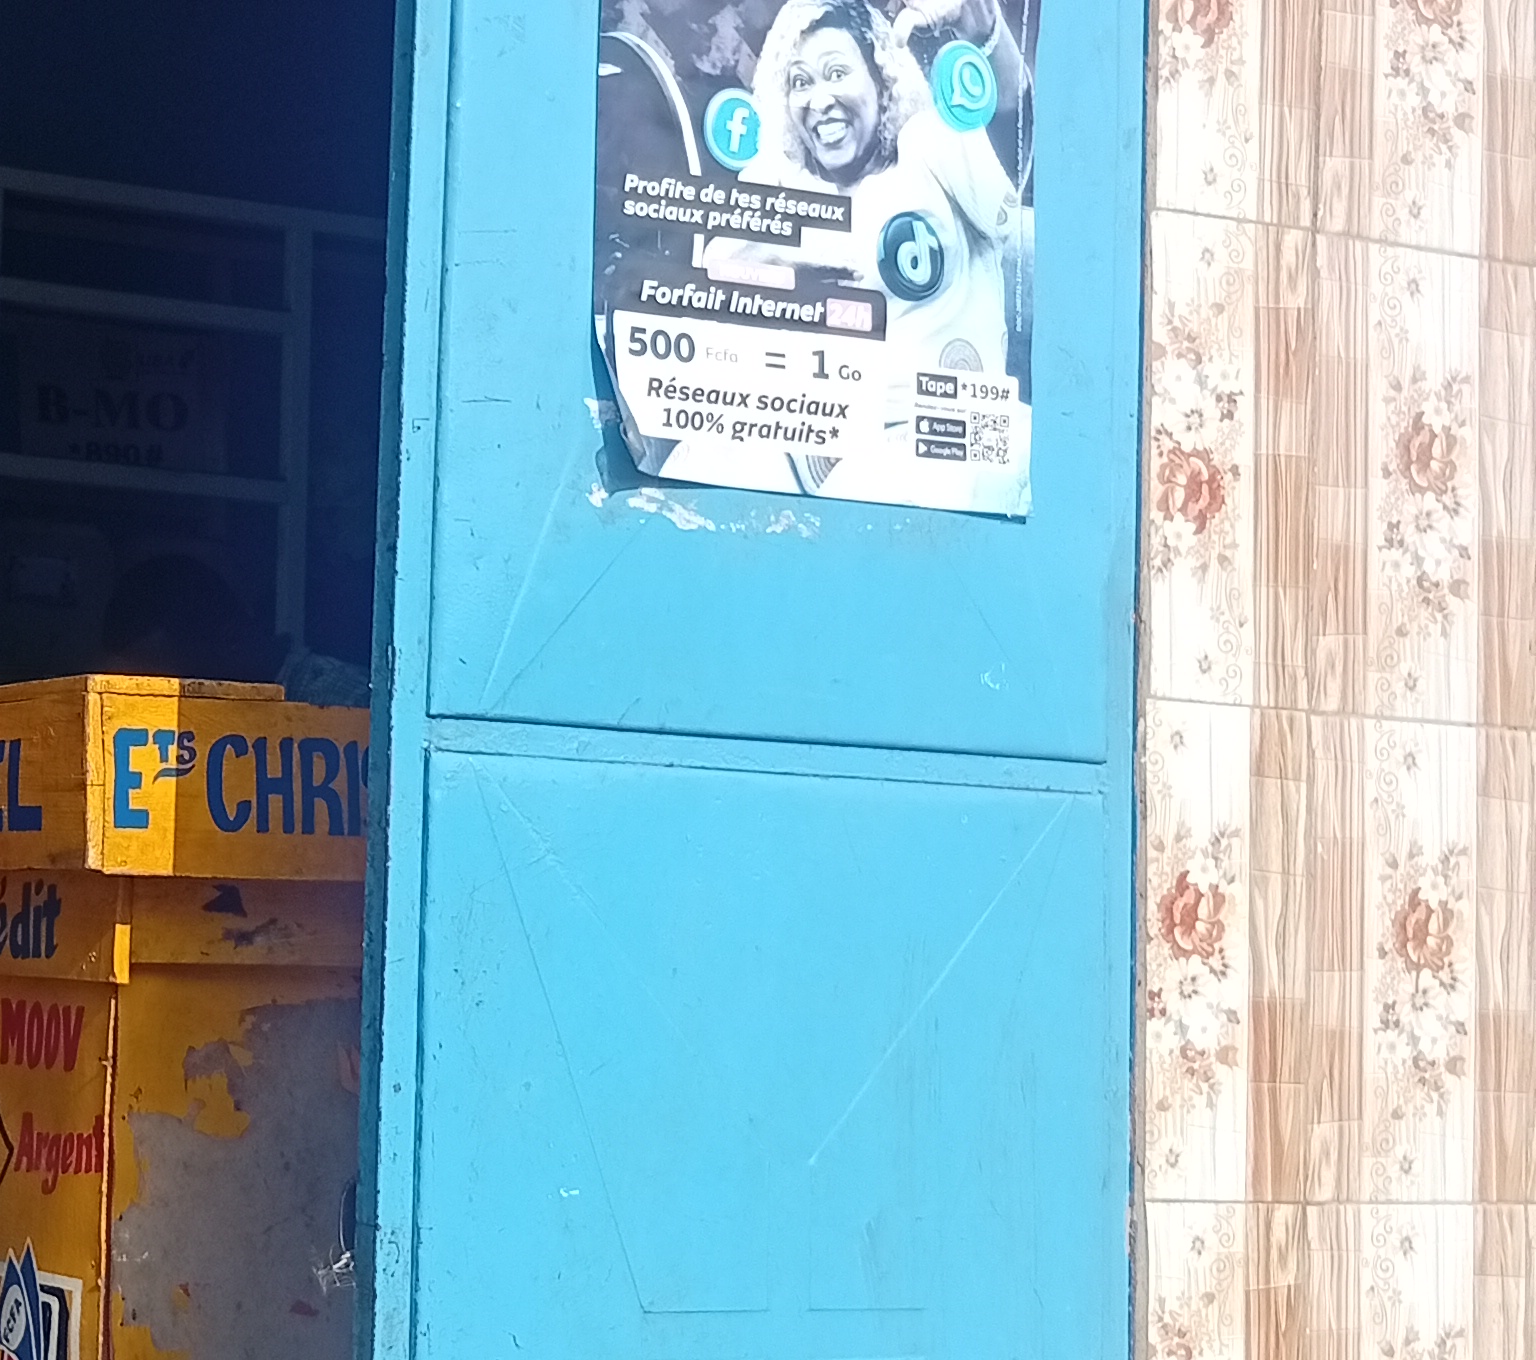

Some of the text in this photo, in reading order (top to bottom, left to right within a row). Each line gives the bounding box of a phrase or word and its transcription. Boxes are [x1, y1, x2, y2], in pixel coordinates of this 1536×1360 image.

[623, 199, 793, 237] sociaux préférés
[624, 173, 845, 222] Profite de tes réseaux
[640, 279, 726, 311] Forfait
[729, 290, 825, 323] Internet
[627, 325, 696, 363] 500
[765, 351, 786, 370] =
[812, 349, 829, 380] 1
[838, 364, 862, 381] Go
[646, 376, 849, 419] Réseaux sociaux
[918, 375, 956, 397] Tape
[662, 407, 724, 435] 100%
[0, 996, 86, 1073] MOOV
[13, 1111, 104, 1196] Argent
